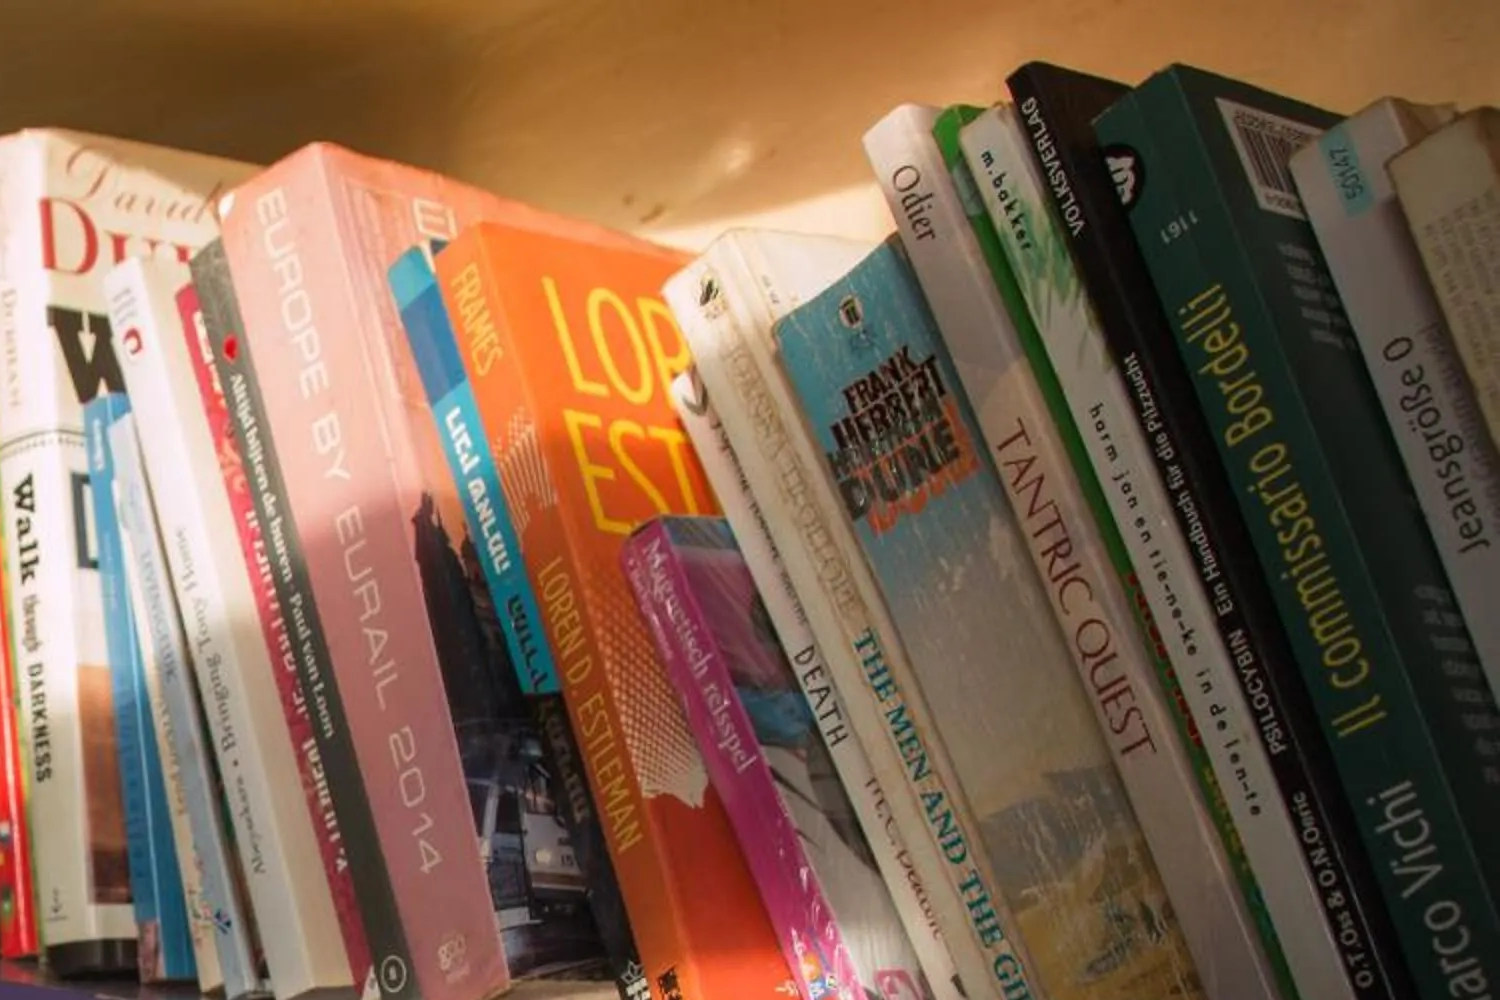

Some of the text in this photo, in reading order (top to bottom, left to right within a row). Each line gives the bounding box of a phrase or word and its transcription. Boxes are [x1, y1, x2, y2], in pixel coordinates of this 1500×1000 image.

[891, 164, 936, 243] Odier
[980, 147, 1033, 254] m.bakker
[1021, 94, 1086, 236] VOLKSVERLAG
[448, 260, 502, 377] FRAMES
[1175, 284, 1275, 447] Bordelli
[842, 345, 918, 413] FRANK
[1121, 349, 1164, 433] Pilzzucht
[1088, 401, 1123, 466] harm
[1150, 428, 1178, 464] die
[1161, 458, 1188, 491] für
[1399, 364, 1491, 556] Jeansgröße
[254, 189, 443, 877] EUROPE BY EURAIL 2014
[1110, 466, 1144, 513] jan
[1133, 513, 1156, 546] en
[1175, 487, 1221, 582] Handbuch
[227, 370, 337, 740] Altijd bijten de buren Paul van Loon
[993, 413, 1091, 618] TANTRIC
[1074, 616, 1154, 757] QUEST
[1145, 546, 1204, 659] tie-ne-ke
[1208, 579, 1235, 616] Ein
[1236, 438, 1375, 695] commissario
[12, 473, 51, 782] Walk through DARKNESS
[187, 596, 216, 653] Tony
[536, 556, 586, 662] LOREN
[642, 538, 713, 680] Magnetisch
[702, 681, 756, 775] reisspel
[200, 652, 238, 754] Bringing
[563, 658, 599, 698] D.
[794, 645, 849, 748] DEATH
[1194, 666, 1217, 695] in
[1205, 697, 1235, 737] de
[1228, 626, 1287, 756] PSILOCYBIN
[1335, 694, 1387, 737] Il
[577, 696, 641, 854] ESTLEMAN
[852, 624, 896, 702] THE
[884, 701, 930, 784] MEN
[921, 785, 967, 869] AND
[957, 869, 1004, 951] THE
[1223, 735, 1267, 819] len-te
[1366, 776, 1447, 901] Vichi
[1323, 885, 1346, 911] &
